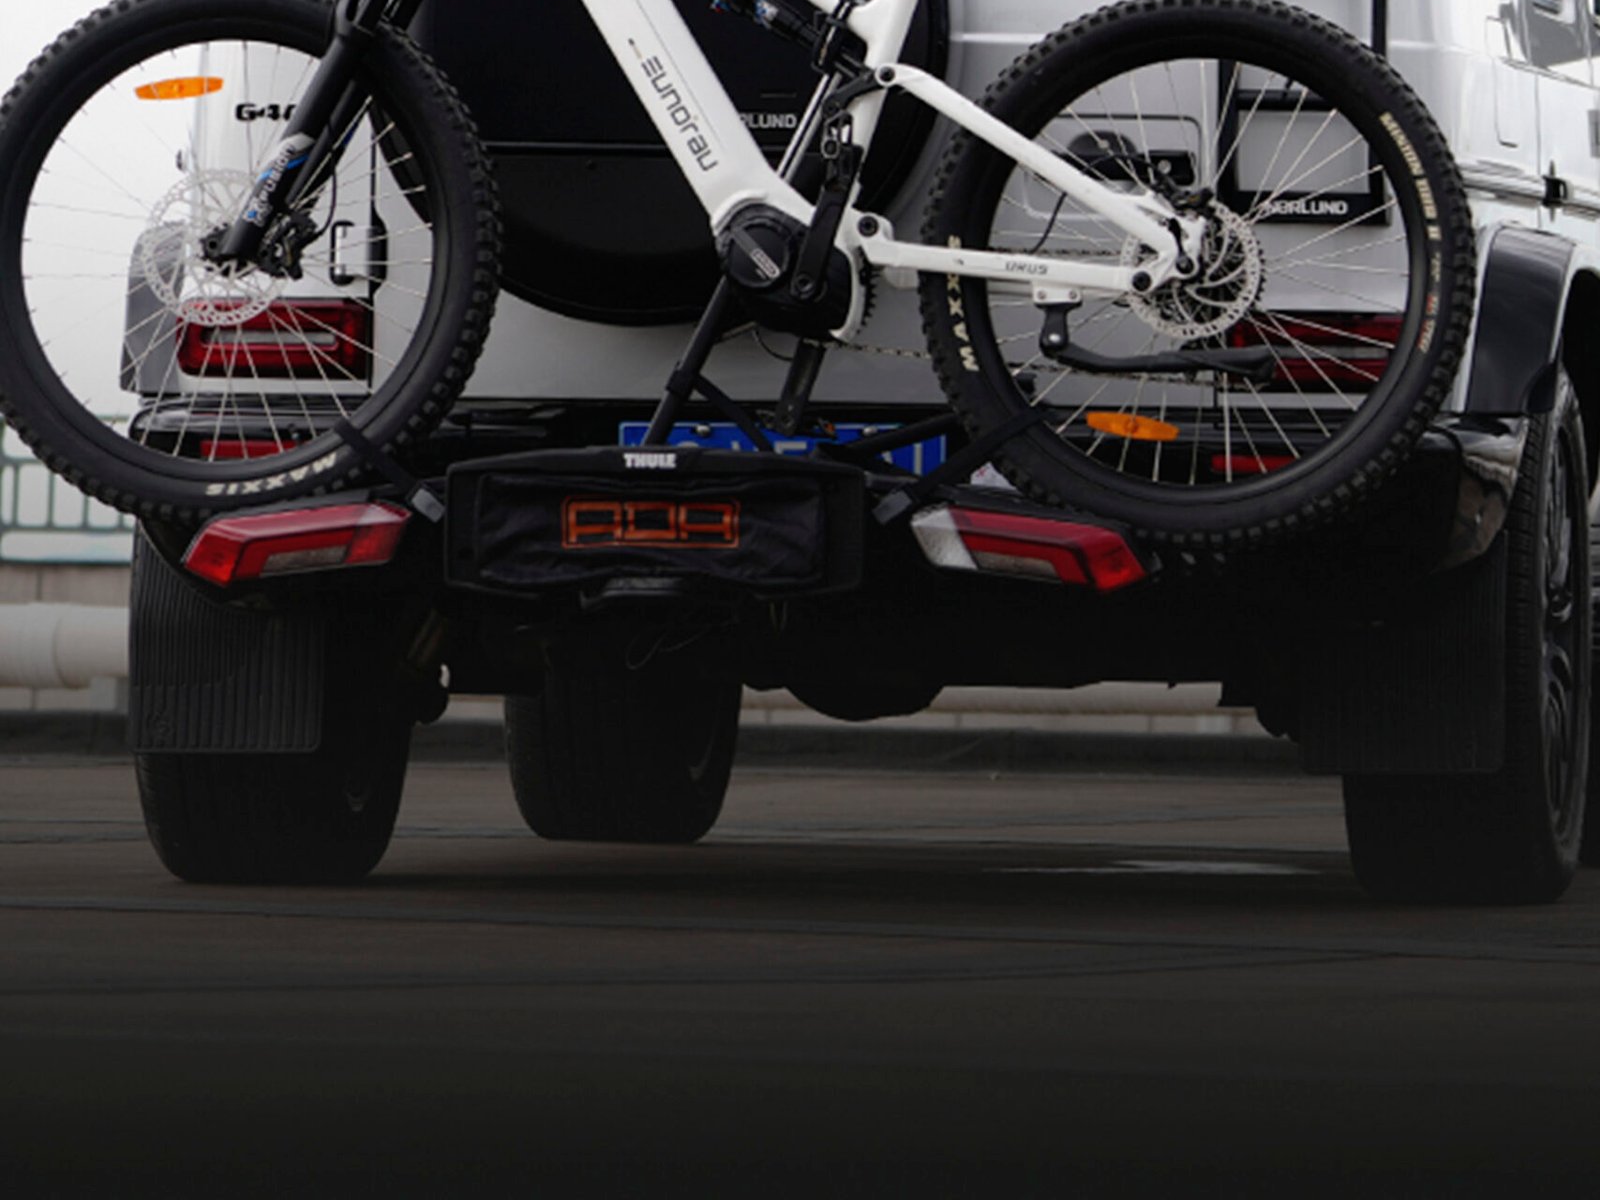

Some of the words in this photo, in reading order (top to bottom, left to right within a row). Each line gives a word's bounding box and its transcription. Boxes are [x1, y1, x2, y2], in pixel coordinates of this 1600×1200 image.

[947, 235, 980, 372] MAXXS
[205, 451, 337, 496] MAXXIS
[624, 452, 677, 468] THULE
